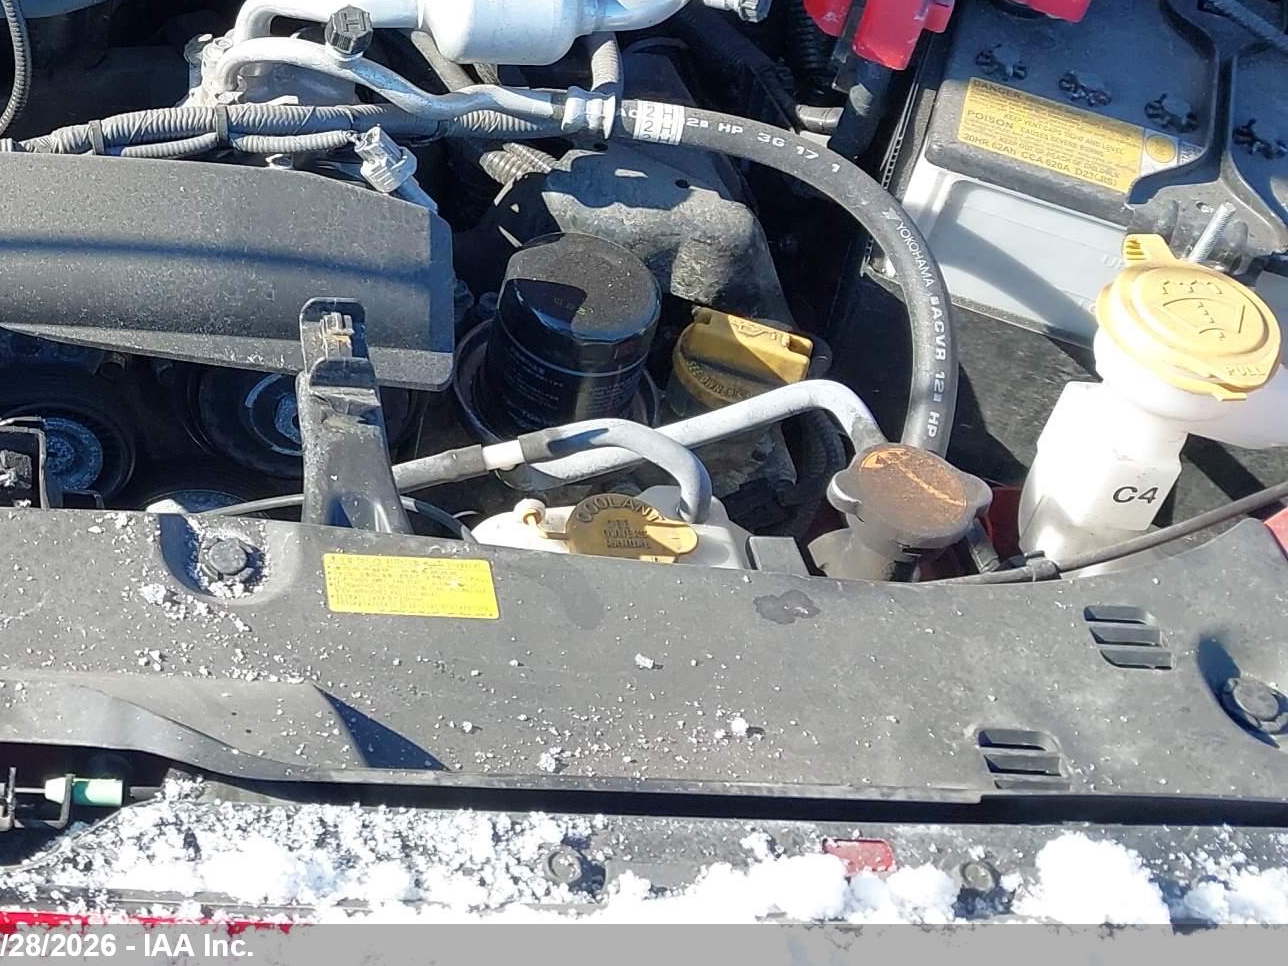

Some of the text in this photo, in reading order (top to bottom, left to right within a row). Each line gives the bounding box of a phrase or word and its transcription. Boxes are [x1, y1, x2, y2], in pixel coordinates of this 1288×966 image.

[718, 122, 744, 134] HP
[967, 109, 1014, 130] POISON
[963, 133, 990, 147] 20HR
[1021, 151, 1044, 163] CCA
[894, 221, 936, 288] YOKOHAMA
[686, 361, 704, 377] SEE
[927, 411, 941, 438] HP
[1112, 485, 1159, 505] C4
[575, 496, 667, 524] COOLANT
